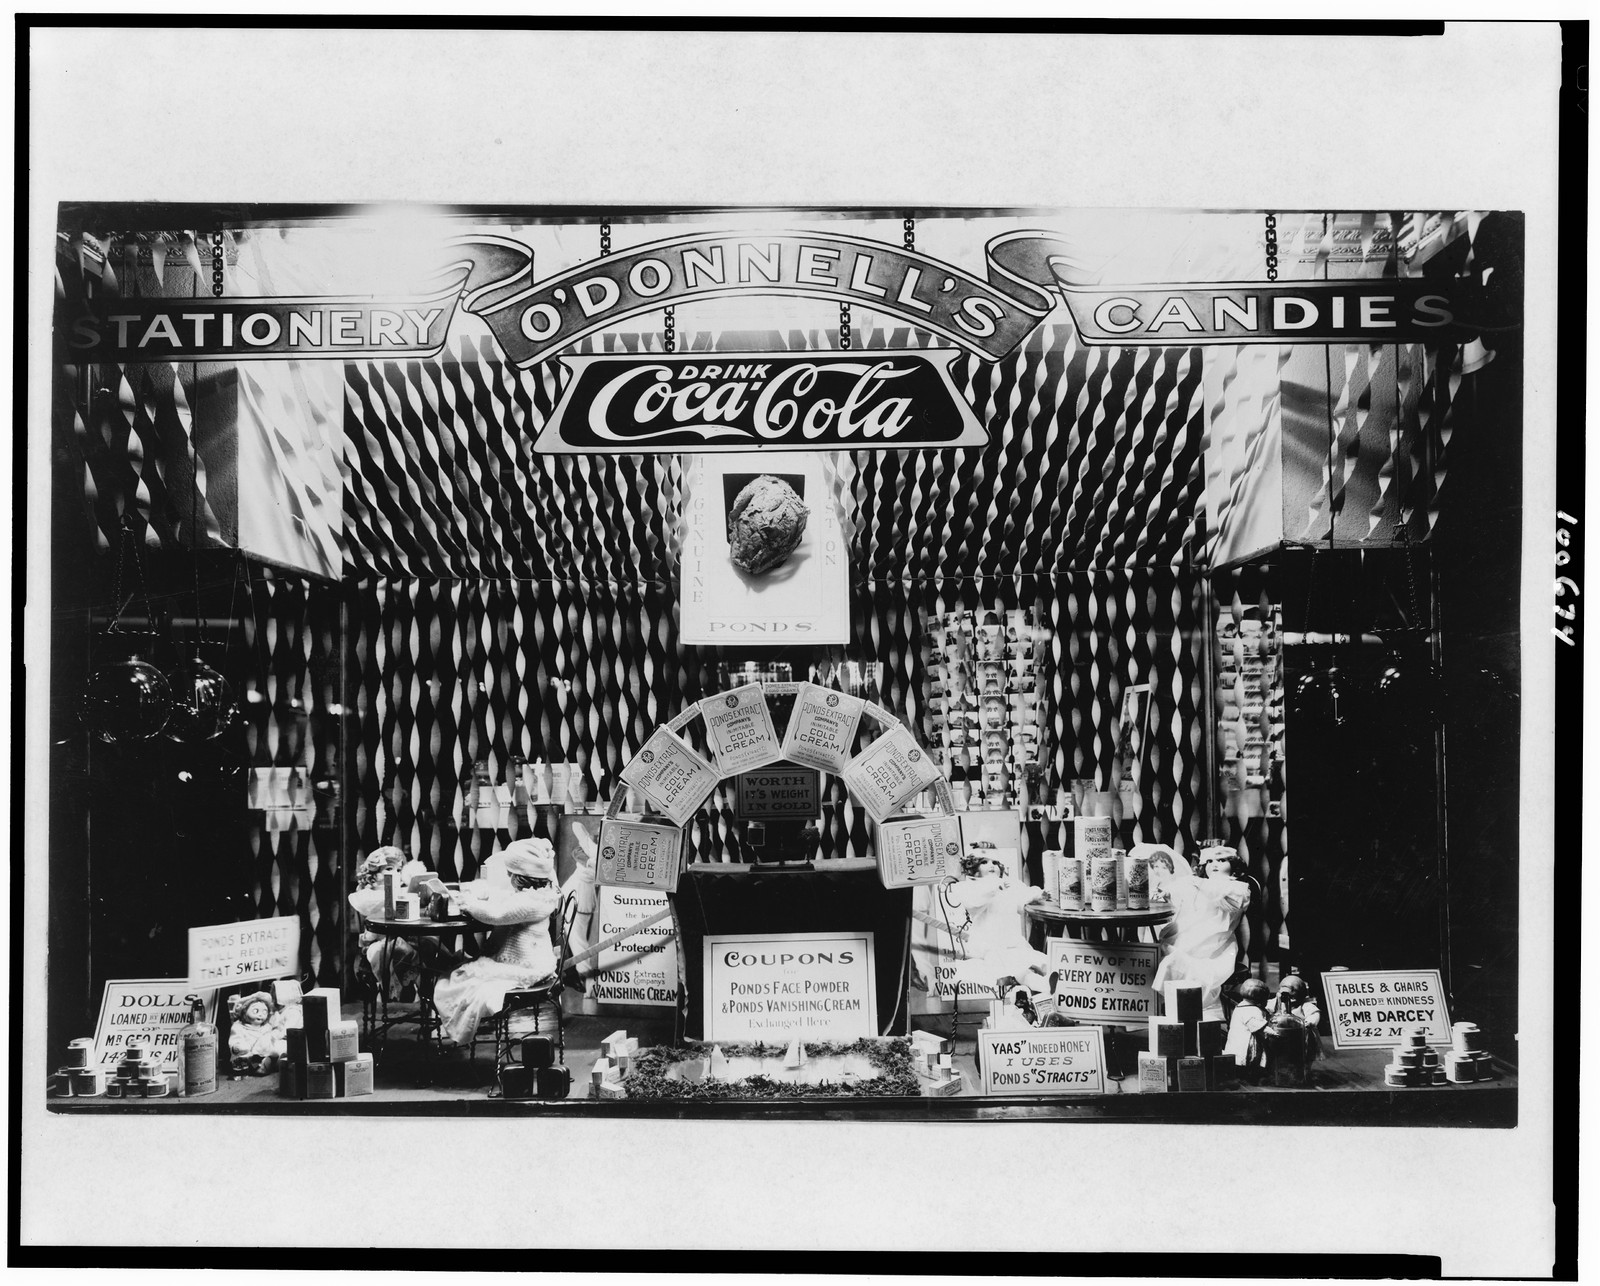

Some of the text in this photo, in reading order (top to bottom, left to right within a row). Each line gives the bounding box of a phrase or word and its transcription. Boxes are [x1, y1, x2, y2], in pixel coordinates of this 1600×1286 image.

[519, 242, 1007, 344] O'DONNELL'S
[1093, 295, 1454, 333] CANDIES
[69, 307, 444, 350] STATIONERY
[678, 363, 773, 381] DRINK
[588, 361, 922, 440] Coca-Cola
[692, 497, 705, 604] GENUINE
[733, 702, 764, 719] EXTRACT
[826, 709, 856, 728] EXTRACT
[730, 728, 756, 742] COLD
[800, 734, 840, 751] CREAM
[810, 728, 836, 741] COLD
[725, 734, 765, 753] CREAM
[654, 742, 681, 770] EXTRACT
[664, 768, 685, 792] COLD
[745, 776, 806, 786] WORTH
[865, 765, 895, 801] CREAM
[877, 766, 897, 789] COLD
[900, 760, 924, 789] EXTRACT
[665, 768, 697, 803] CREAM
[745, 788, 810, 799] IT'S WEIGHT
[747, 801, 812, 811] IN GOLD
[639, 843, 648, 869] COLD
[647, 837, 657, 878] CREAM
[904, 833, 914, 874] CREAM
[914, 840, 922, 866] COLD
[613, 894, 669, 906] Summer
[240, 927, 288, 945] EXTRACT
[240, 943, 288, 958] REDUCE
[613, 941, 666, 953] Protector
[200, 956, 289, 979] THAT SWELLING
[723, 950, 855, 968] COUPONS
[1060, 953, 1151, 968] A FEW OF THE
[634, 970, 666, 978] Extract
[1058, 969, 1146, 986] EVERY DAY USES
[592, 983, 645, 1001] VANISHING
[773, 980, 802, 995] FACE
[804, 979, 850, 994] POWDER
[1336, 981, 1428, 994] TABLES & CHAIRS
[120, 993, 199, 1007] DOLLS
[766, 996, 823, 1013] VANISHING
[823, 997, 861, 1012] CREAM
[1058, 994, 1097, 1010] PONDS
[1101, 997, 1150, 1012] EXTRACT
[1338, 997, 1377, 1007] LOANED
[1386, 996, 1435, 1006] KINDNESS
[110, 1013, 148, 1025] LOANED
[748, 1015, 831, 1030] Exchanged Here
[1352, 1011, 1371, 1022] MR
[1376, 1010, 1435, 1022] DARCEY
[105, 1034, 123, 1047] MR
[1345, 1028, 1382, 1037] 3142
[1028, 1042, 1059, 1054] INDEED
[1060, 1041, 1091, 1053] HONEY
[1006, 1056, 1074, 1067] I USES
